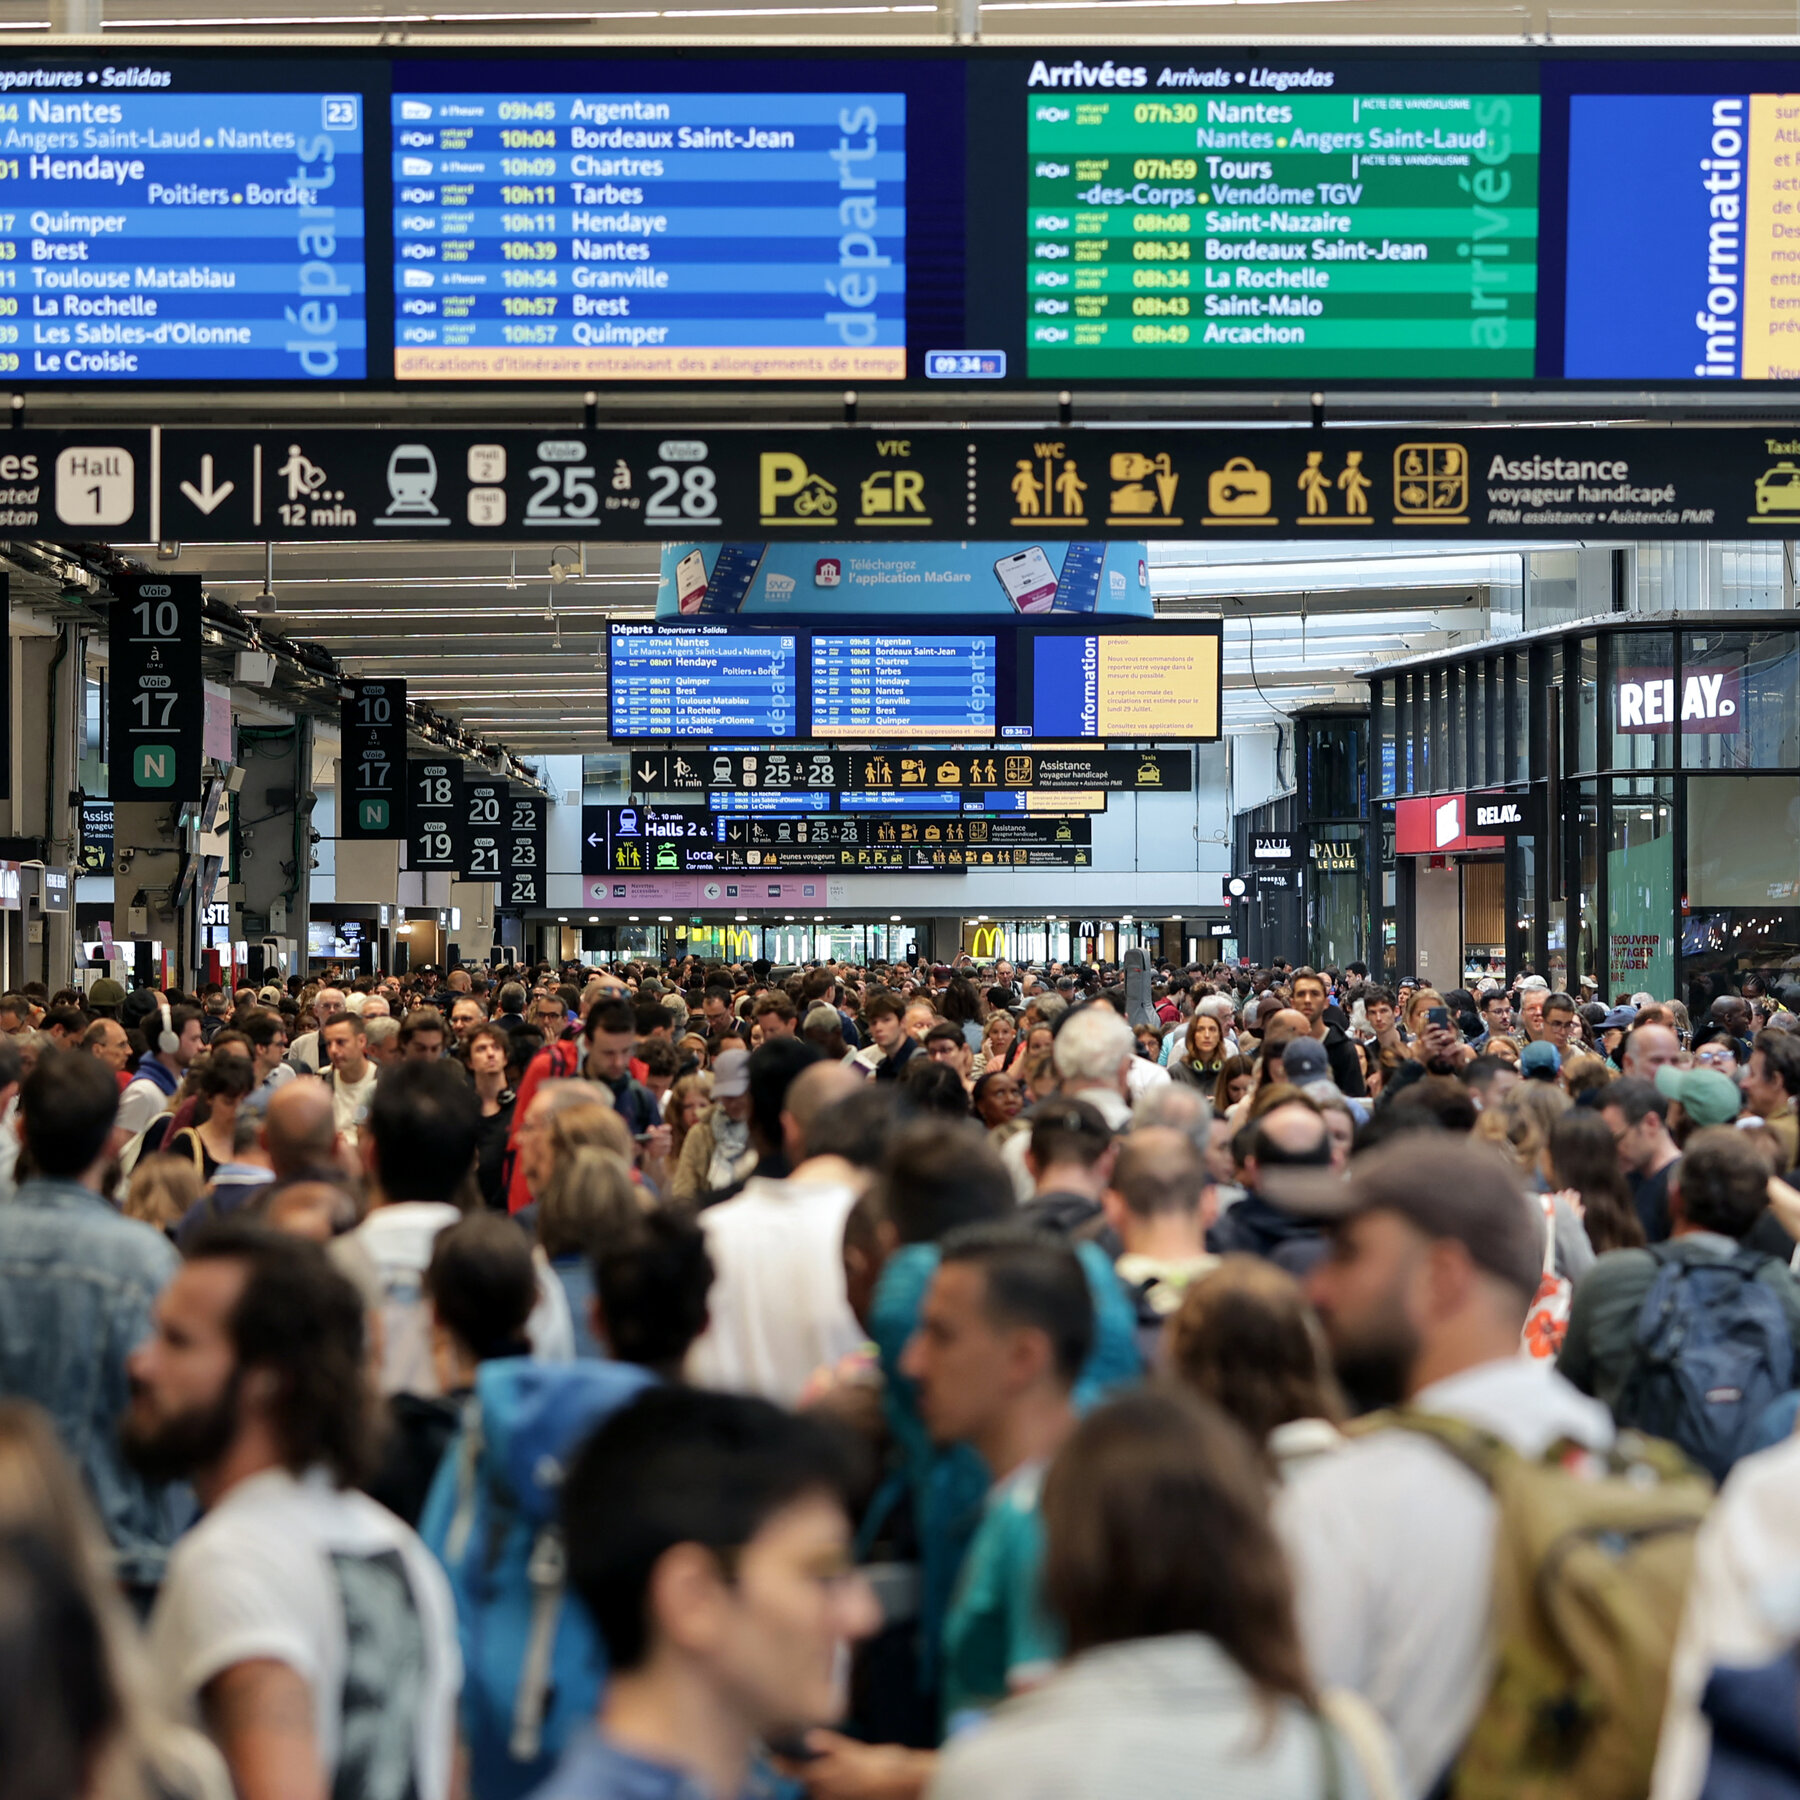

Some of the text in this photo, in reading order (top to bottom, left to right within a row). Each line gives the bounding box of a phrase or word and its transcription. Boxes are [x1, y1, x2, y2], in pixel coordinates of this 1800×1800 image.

[101, 67, 171, 86] Salidas
[1028, 61, 1334, 91] Arrivées Arrivals Llegadas
[29, 99, 122, 123] Nantes
[327, 104, 353, 122] 23
[498, 99, 669, 125] 09h45 Argentan
[1135, 101, 1292, 123] 07h30 Nantes
[5, 128, 296, 152] Angers Saint-Laud Nantes
[500, 127, 794, 148] 10h04 Bordeaux Saint-Jean
[1197, 128, 1487, 152] Nantes Angers Saint-Laud
[30, 156, 144, 185] Hendaye
[501, 155, 664, 176] 10h09 Chartres
[1134, 156, 1272, 179] 07h59 Tours
[148, 183, 229, 204] Poitiers
[501, 183, 643, 204] 10h11 Tarbes
[1211, 184, 1315, 204] Vendôme
[1317, 183, 1362, 204] TGV
[30, 211, 126, 237] Quimper
[501, 212, 667, 236] 10h11 Hendaye
[824, 106, 891, 345] départs
[1206, 211, 1351, 232] Saint-Nazaire
[1457, 100, 1512, 348] arrivées
[1695, 100, 1743, 377] information
[32, 239, 88, 260] Brest
[286, 134, 350, 376] départs
[501, 239, 650, 260] 10h39 Nantes
[1206, 239, 1306, 260] Bordeaux
[1312, 239, 1427, 260] Saint-Jean
[32, 267, 235, 288] Toulouse Matabiau
[502, 267, 668, 288] 10h54 Granville
[1205, 267, 1329, 288] La Rochelle
[33, 295, 157, 316] La Rochelle
[502, 294, 629, 315] 10h57 Brest
[1205, 295, 1323, 315] Saint-Malo
[34, 322, 251, 343] Les Sables-d'Olonne
[503, 322, 668, 346] 10h57 Quimper
[1204, 323, 1305, 343] Arcachon
[35, 350, 137, 371] Le Croisic
[935, 357, 982, 373] 09:34
[877, 440, 910, 456] VTC
[1034, 443, 1064, 458] WC
[71, 457, 120, 476] Hall
[612, 460, 631, 489] à
[1488, 455, 1628, 480] Assistance
[527, 467, 600, 518] 25
[645, 466, 717, 518] 28
[760, 453, 808, 515] P
[88, 486, 100, 514] 1
[1487, 484, 1675, 507] voyageur handicapé
[279, 504, 356, 526] 12 min
[849, 559, 916, 572] Téléchargez
[848, 571, 971, 586] l'application MaGare
[143, 586, 167, 596] Voie
[133, 602, 178, 635] 10
[612, 624, 653, 636] Départs
[658, 627, 696, 635] Departures
[668, 648, 693, 657] Angers
[676, 638, 709, 647] Nantes
[876, 638, 911, 647] Argentan
[150, 647, 159, 660] à
[676, 658, 717, 668] Hendaye
[143, 677, 167, 687] Voie
[676, 678, 710, 686] Quimper
[723, 668, 751, 676] Poitiers
[876, 678, 910, 686] Hendaye
[766, 651, 791, 736] départs
[966, 640, 990, 726] départs
[1081, 637, 1096, 735] information
[132, 693, 178, 725] 17
[356, 698, 392, 722] 10
[676, 697, 749, 705] Toulouse Matabiau
[876, 697, 910, 705] Granville
[876, 717, 910, 725] Quimper
[145, 755, 164, 777] N
[356, 762, 392, 786] 17
[763, 765, 791, 784] 25
[808, 765, 836, 783] 28
[1040, 761, 1091, 771] Assistance
[1040, 771, 1108, 780] voyageur handicapé
[417, 778, 453, 802] 18
[468, 799, 501, 821] 20
[511, 810, 536, 827] 22
[1477, 804, 1517, 825] RELAY
[645, 822, 708, 836] Halls 2 &
[417, 834, 453, 858] 19
[511, 846, 536, 863] 23
[1256, 839, 1291, 849] PAUL
[1314, 844, 1355, 858] PAUL
[470, 849, 501, 870] 21
[1318, 859, 1355, 869] LE CAFÉ
[511, 883, 536, 900] 24
